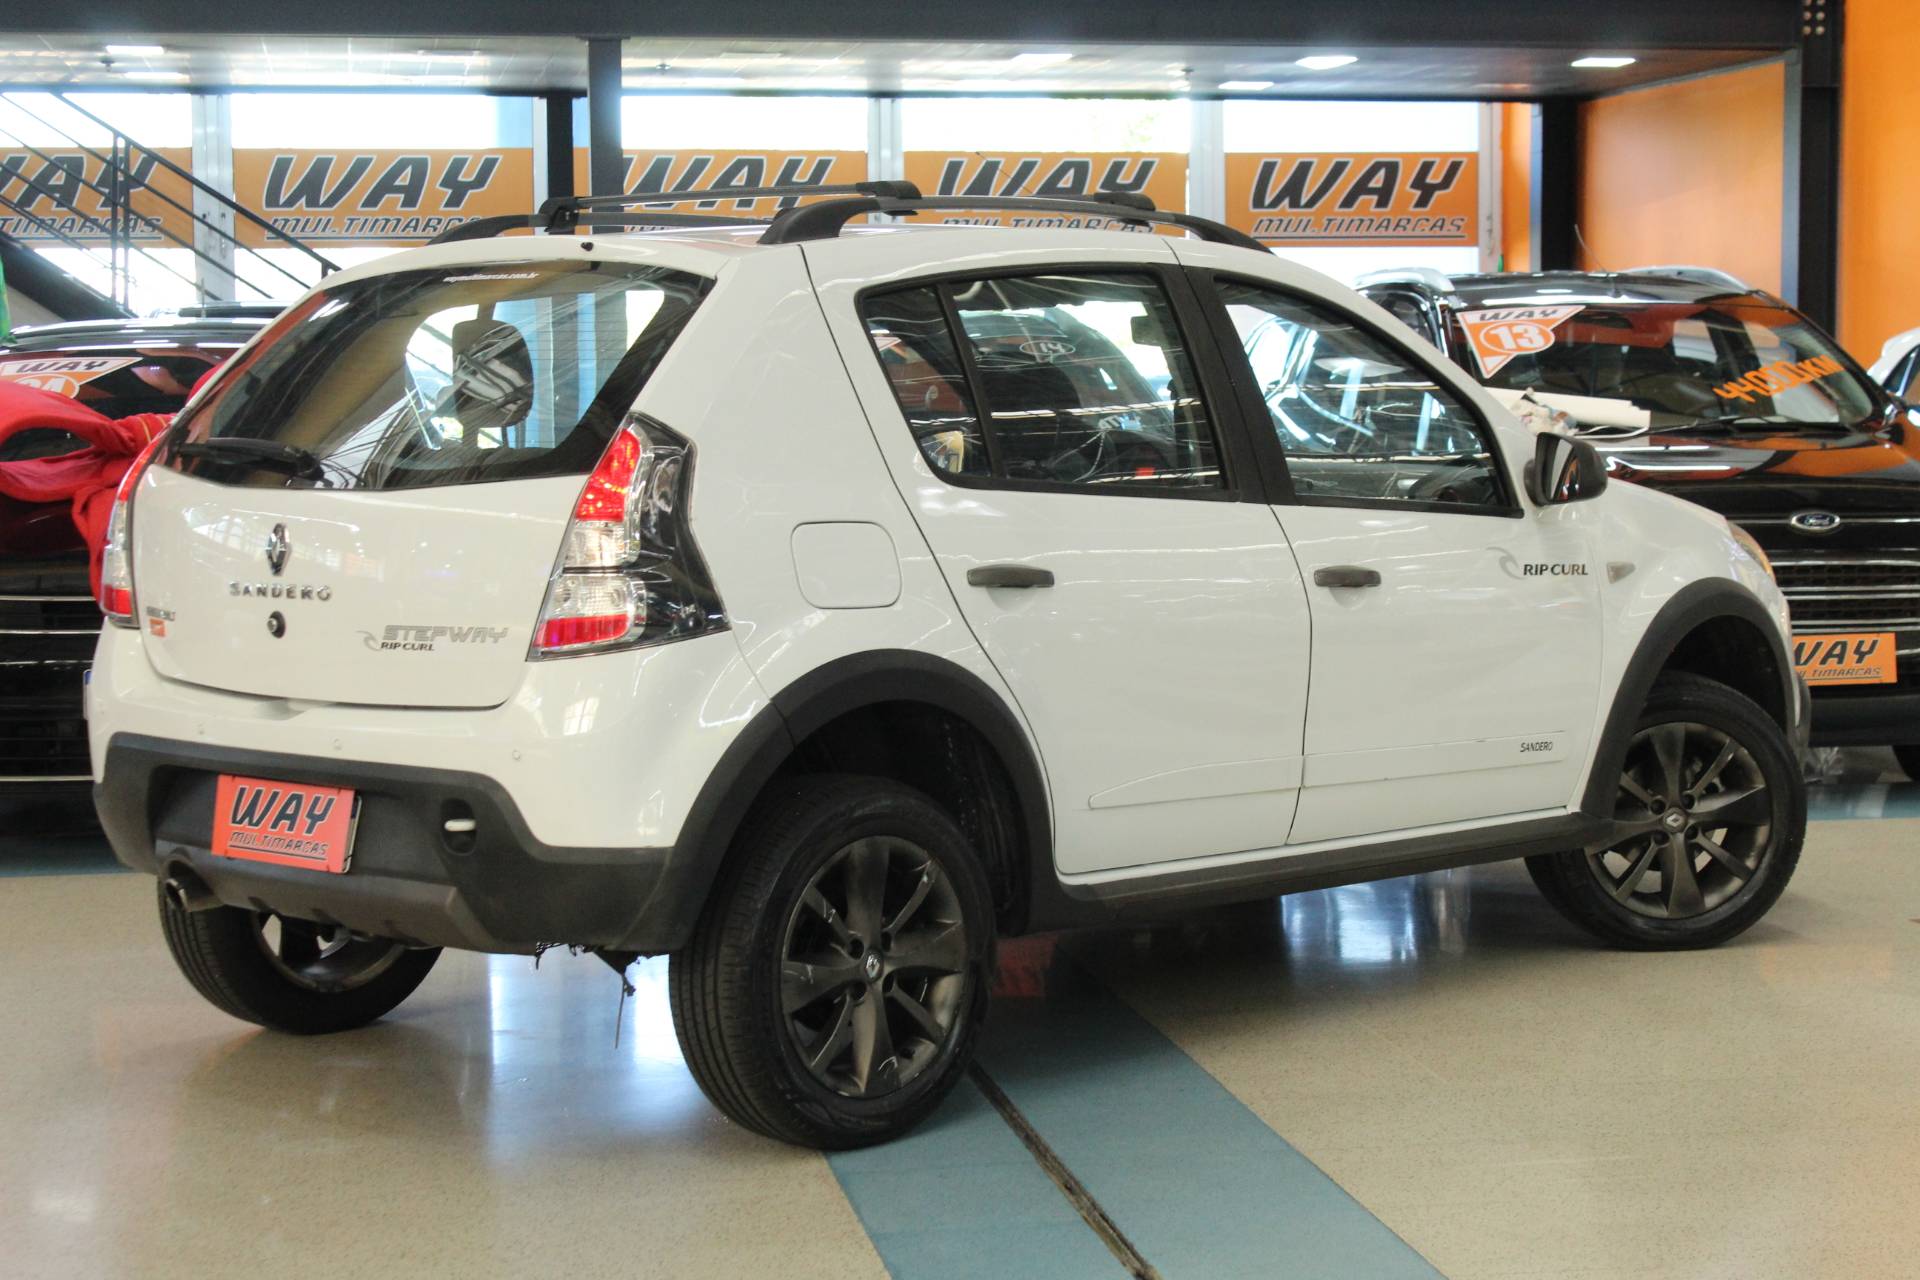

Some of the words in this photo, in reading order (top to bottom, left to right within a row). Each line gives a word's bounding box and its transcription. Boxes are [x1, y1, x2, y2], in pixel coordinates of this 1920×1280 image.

[263, 155, 503, 211] WAY
[622, 155, 837, 210] WAY
[936, 157, 1160, 212] WAY
[1249, 158, 1467, 212] WAY
[1253, 217, 1466, 233] MULTIMARCAS
[1479, 309, 1557, 321] WAY
[1489, 324, 1545, 350] 13
[16, 360, 109, 373] WAY
[1522, 563, 1549, 576] RIP
[1549, 563, 1589, 576] CURL
[229, 581, 332, 601] SANDERO
[382, 624, 509, 643] STEPWAY
[380, 641, 401, 651] RIP
[402, 642, 436, 652] CURL
[1519, 740, 1553, 753] SANDERO
[229, 784, 337, 837] WAY
